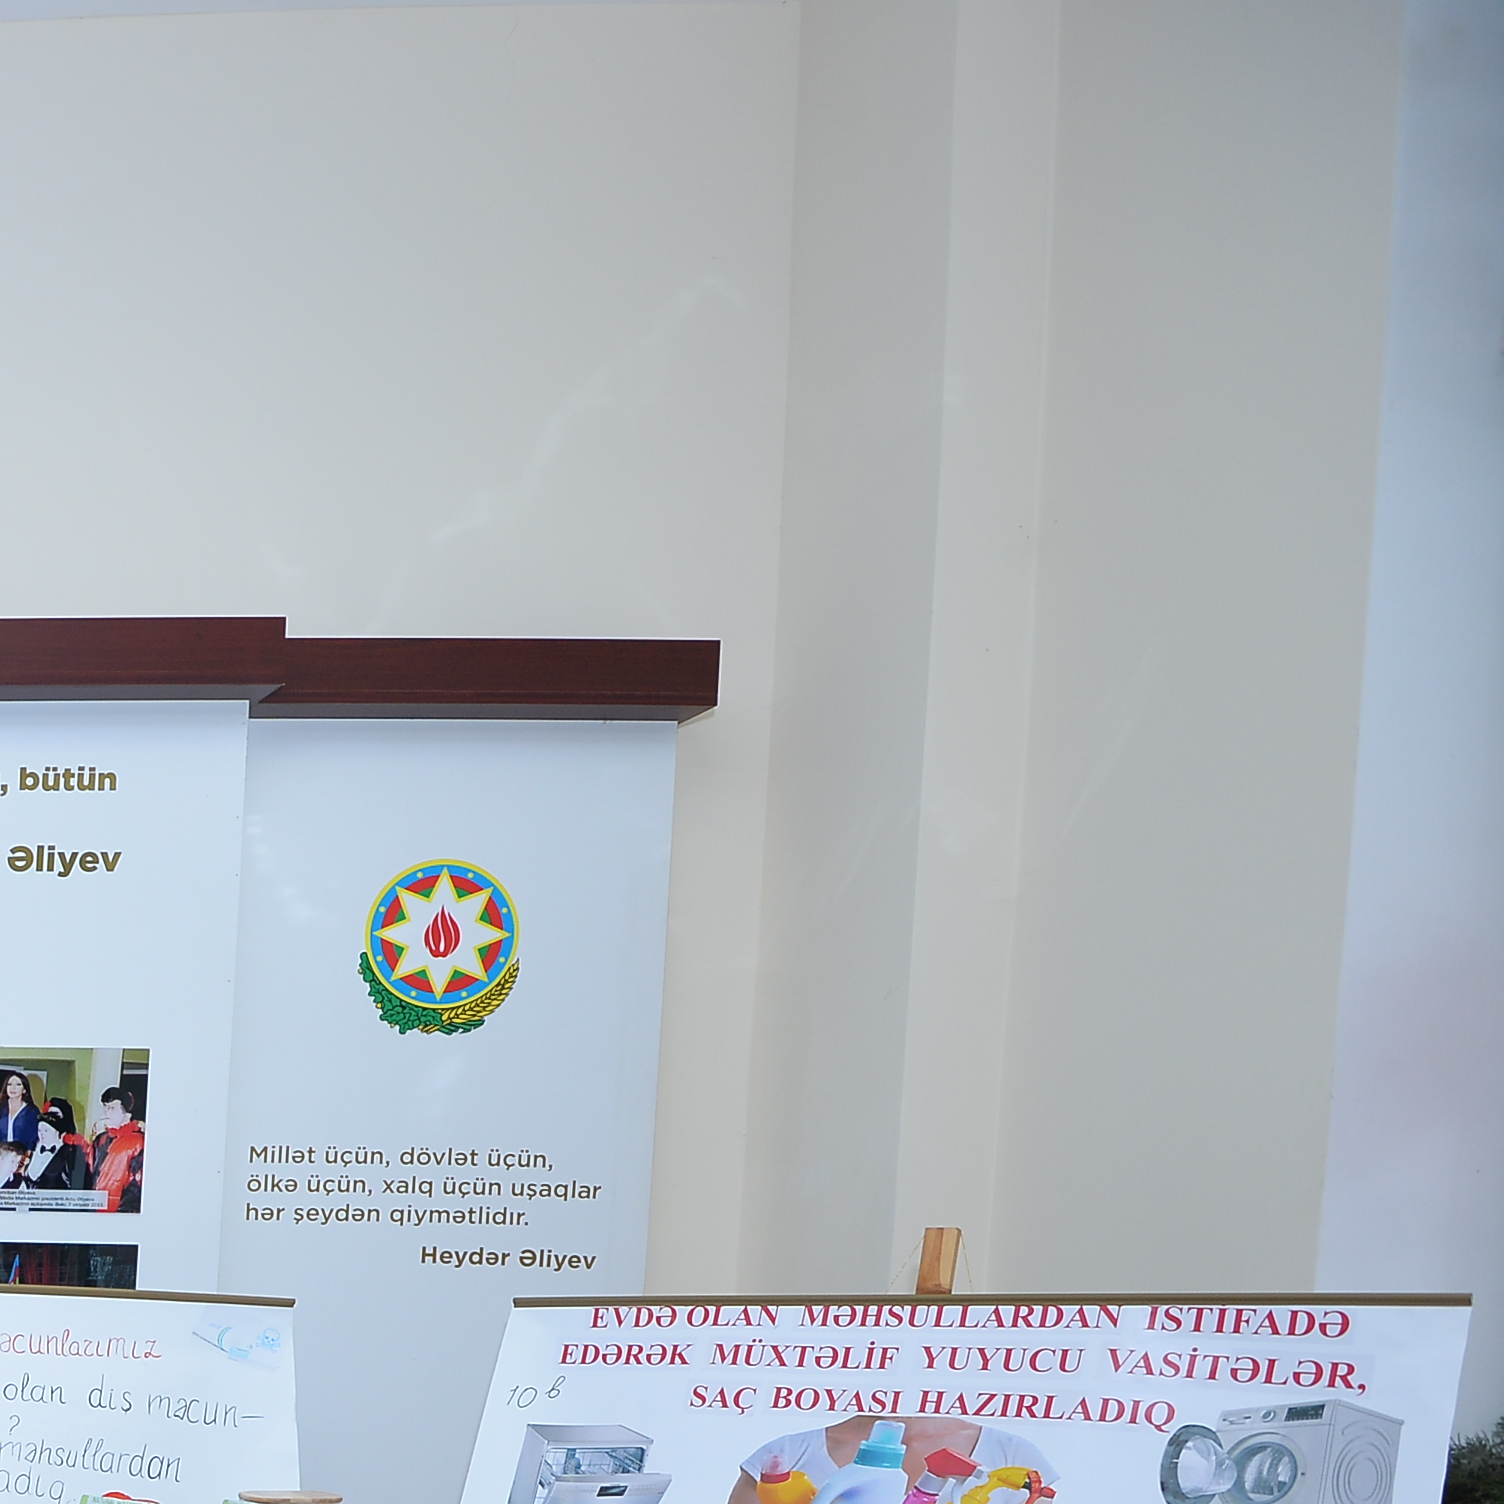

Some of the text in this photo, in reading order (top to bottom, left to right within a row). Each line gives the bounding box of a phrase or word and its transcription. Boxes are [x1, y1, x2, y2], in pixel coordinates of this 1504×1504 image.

[18, 765, 117, 793] bütün
[7, 845, 122, 878] Əliyev
[249, 1145, 553, 1171] Millət üçün, dövlət üçün,
[247, 1173, 602, 1201] ölkə üçün, xalq üçün uşaqlar
[245, 1203, 285, 1222] hər
[293, 1204, 381, 1226] şeydən
[421, 1246, 597, 1271] Heydər Əliyev
[589, 1305, 677, 1329] EVDƏ
[686, 1304, 780, 1329] OLAN
[798, 1304, 1122, 1330] MƏHSULLARDAN
[559, 1338, 1367, 1397] EDƏRƏK MÜXTƏLİF YUYUCU VASİTƏLƏR,
[2, 1372, 67, 1405] olan
[506, 1384, 538, 1410] 10
[689, 1384, 1177, 1434] SAÇ BOYASI HAZIRLADIQ
